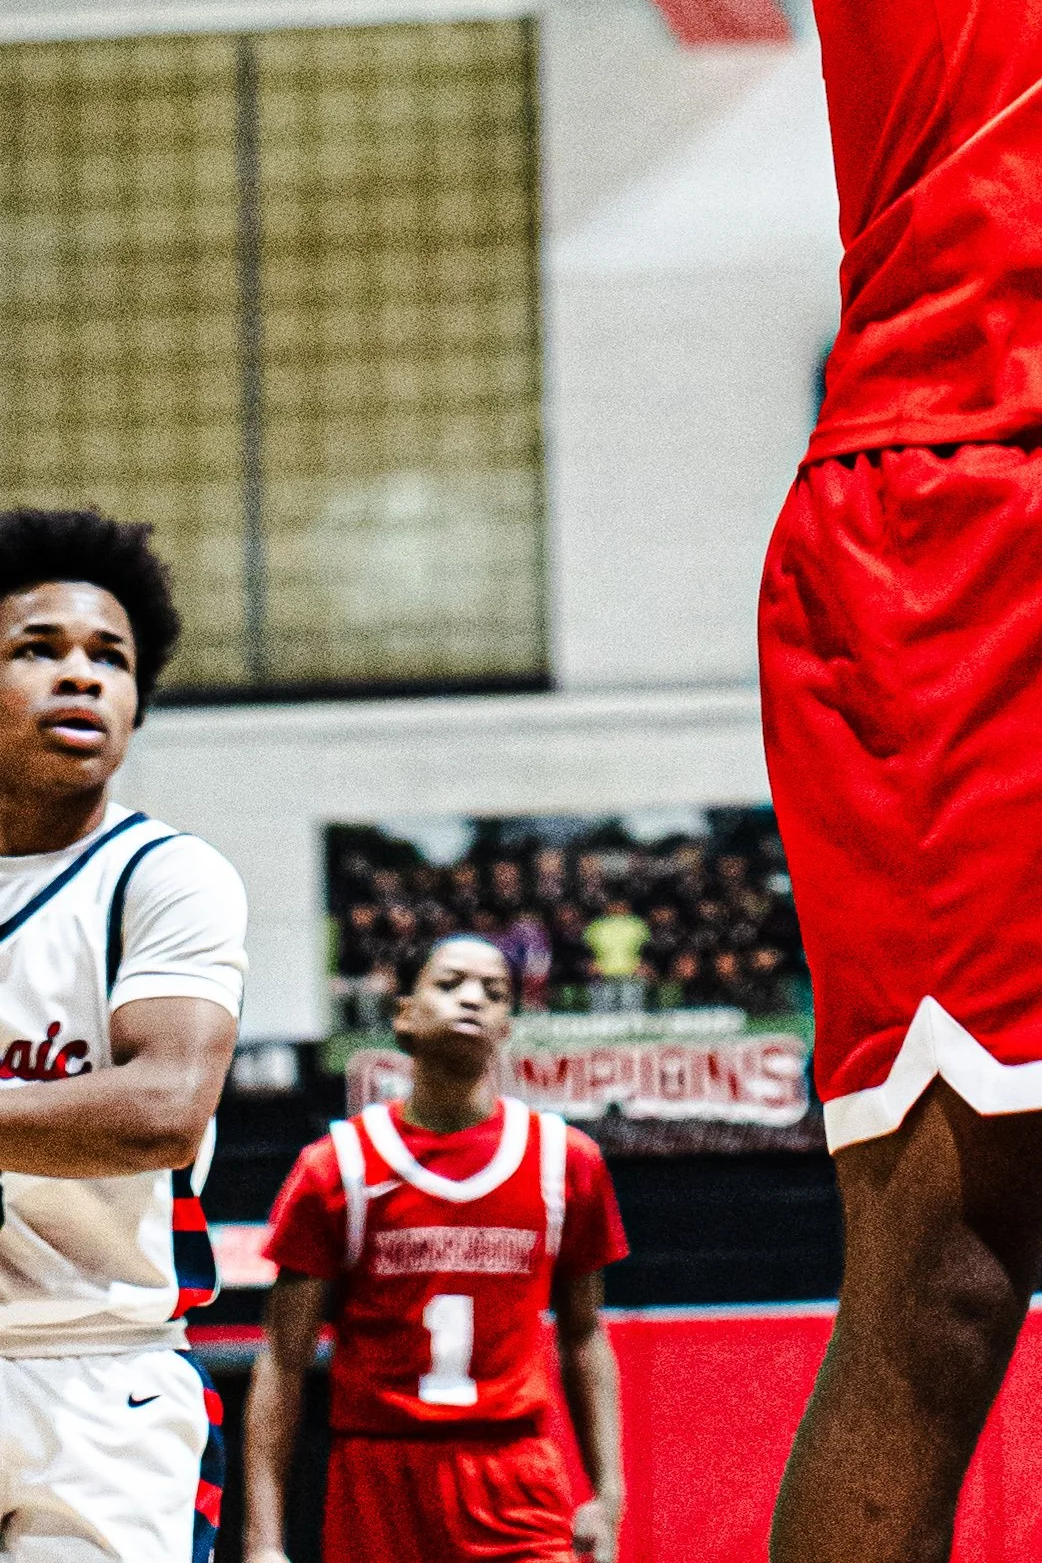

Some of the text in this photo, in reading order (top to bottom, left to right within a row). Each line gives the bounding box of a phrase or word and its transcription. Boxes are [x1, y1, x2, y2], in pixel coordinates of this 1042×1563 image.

[0, 1021, 93, 1082] aic
[348, 1040, 804, 1124] CMPIONS
[418, 1293, 479, 1406] 1
